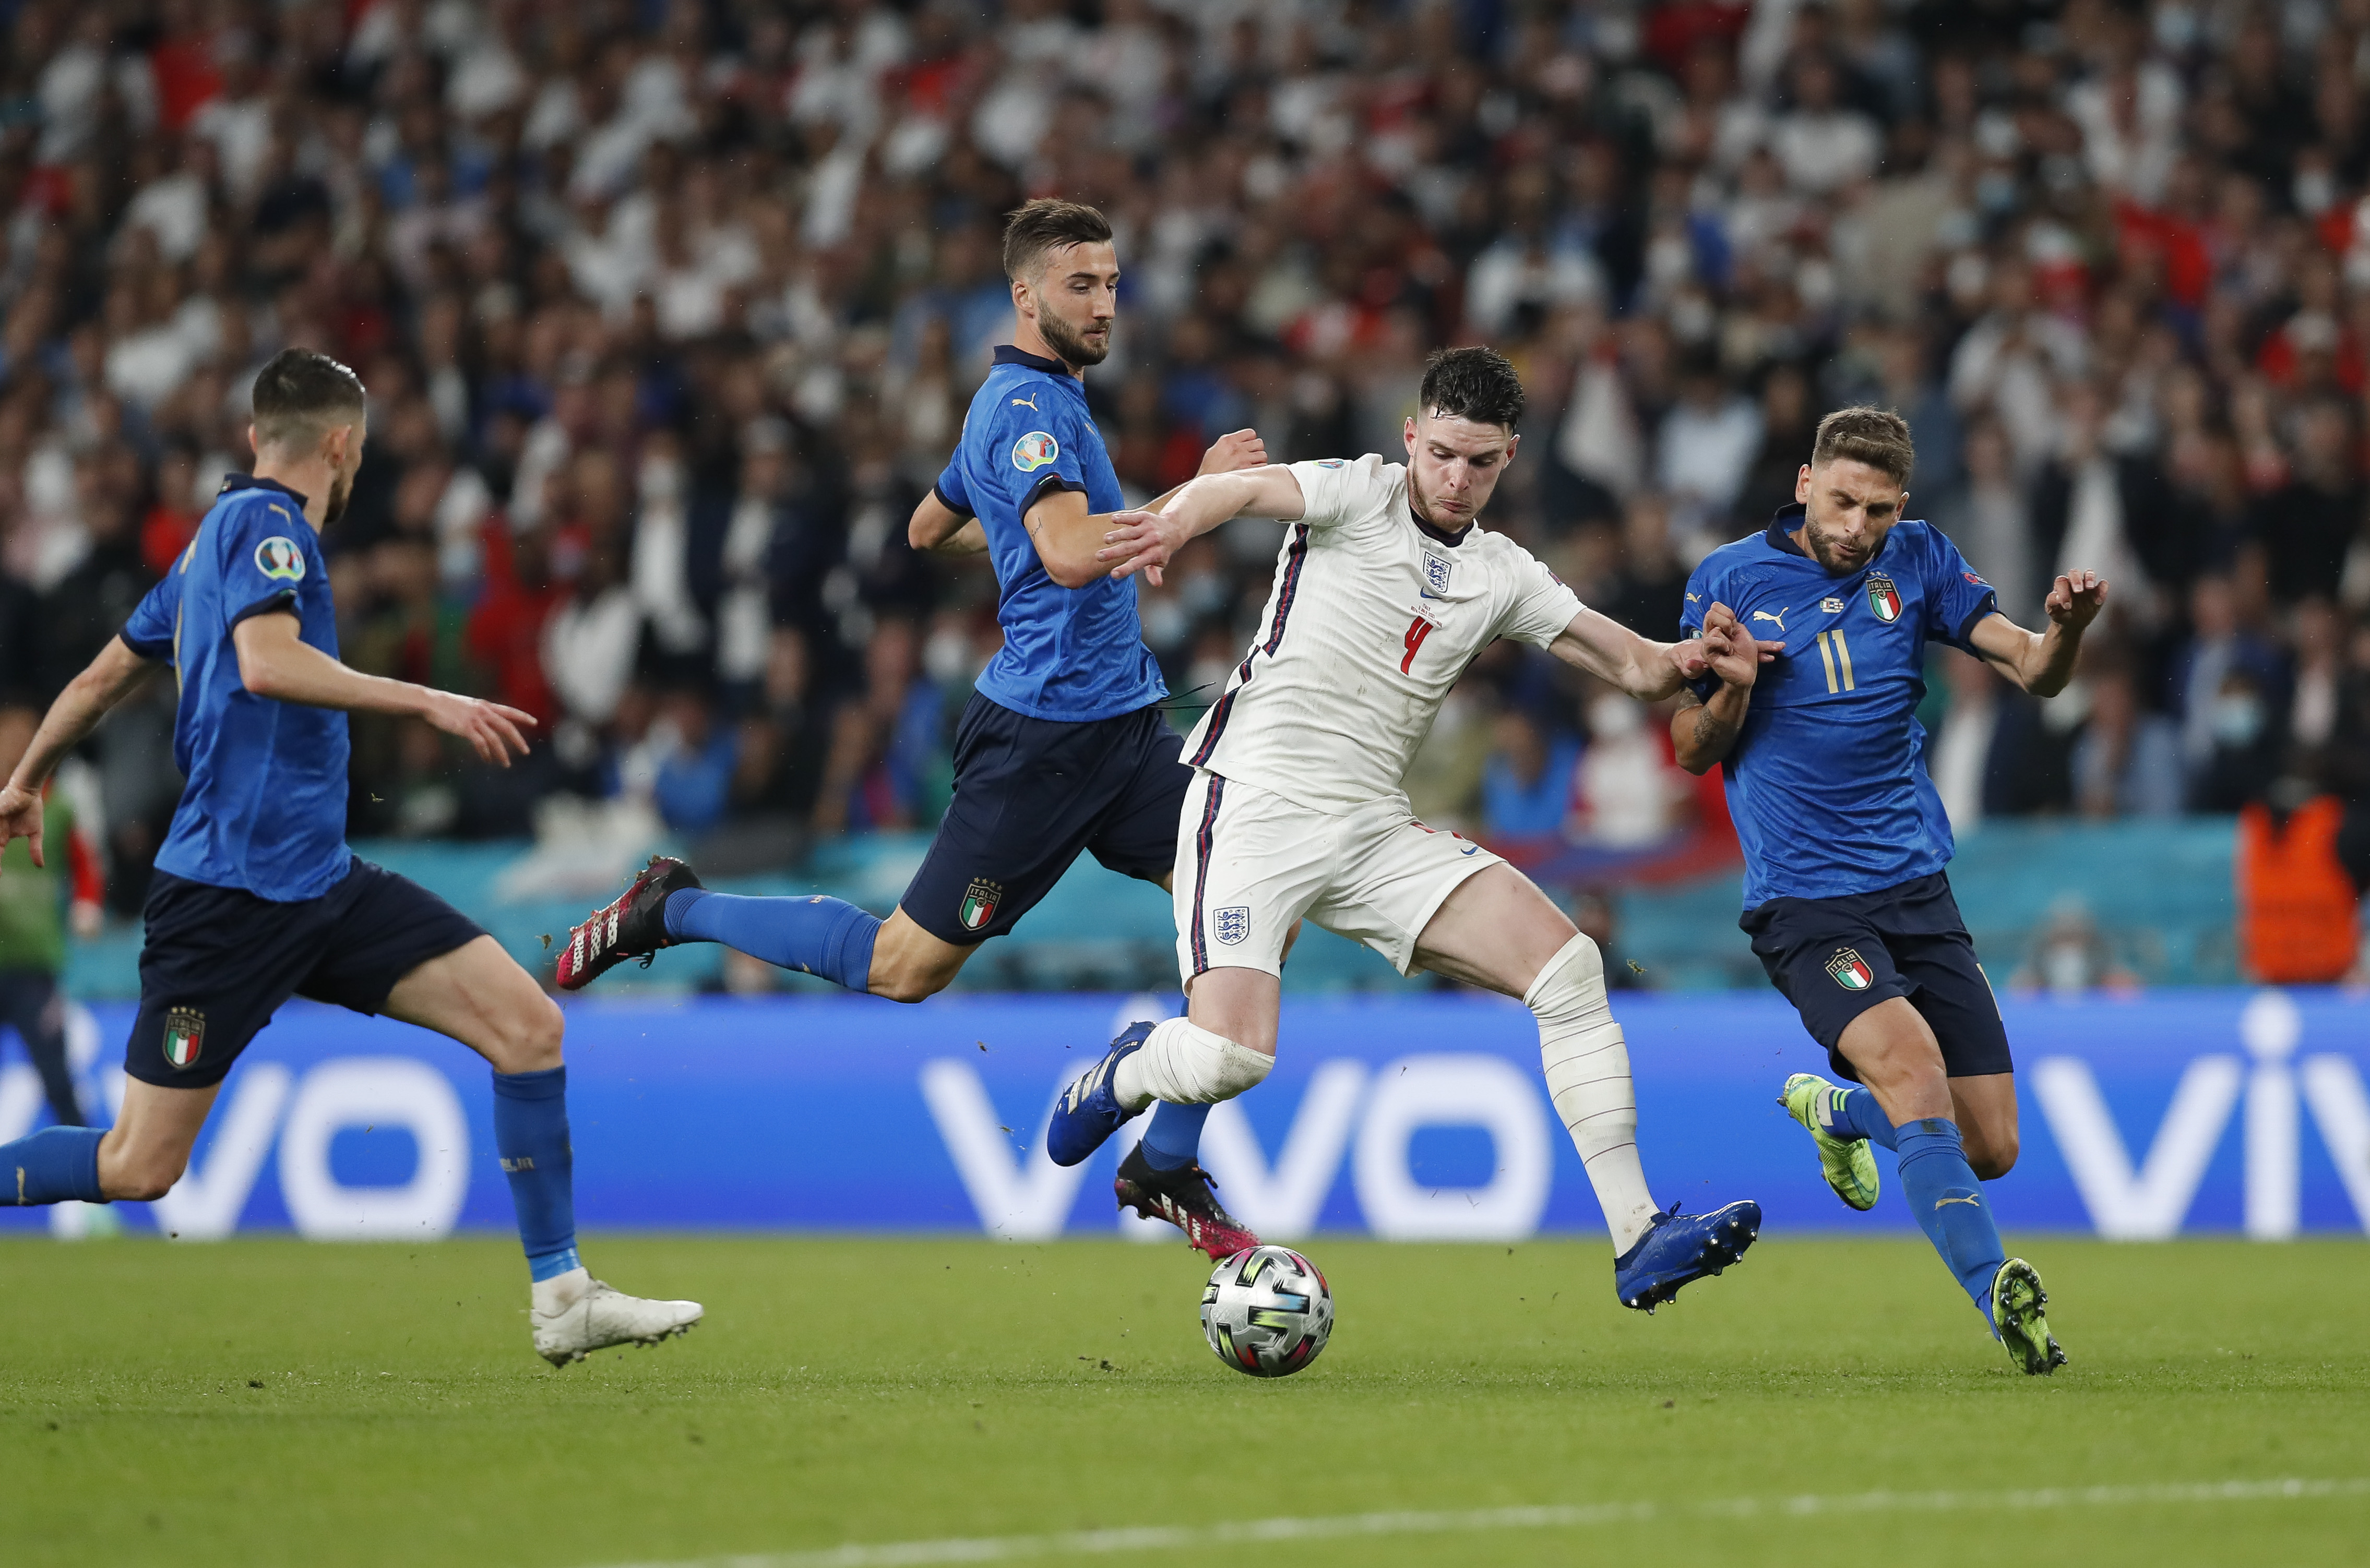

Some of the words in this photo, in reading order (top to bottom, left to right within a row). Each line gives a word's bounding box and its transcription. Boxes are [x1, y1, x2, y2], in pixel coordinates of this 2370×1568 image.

[1401, 615, 1434, 676] 4
[1817, 629, 1855, 694] 11
[971, 888, 997, 901] ITALIA
[1830, 953, 1856, 973] ITALIA
